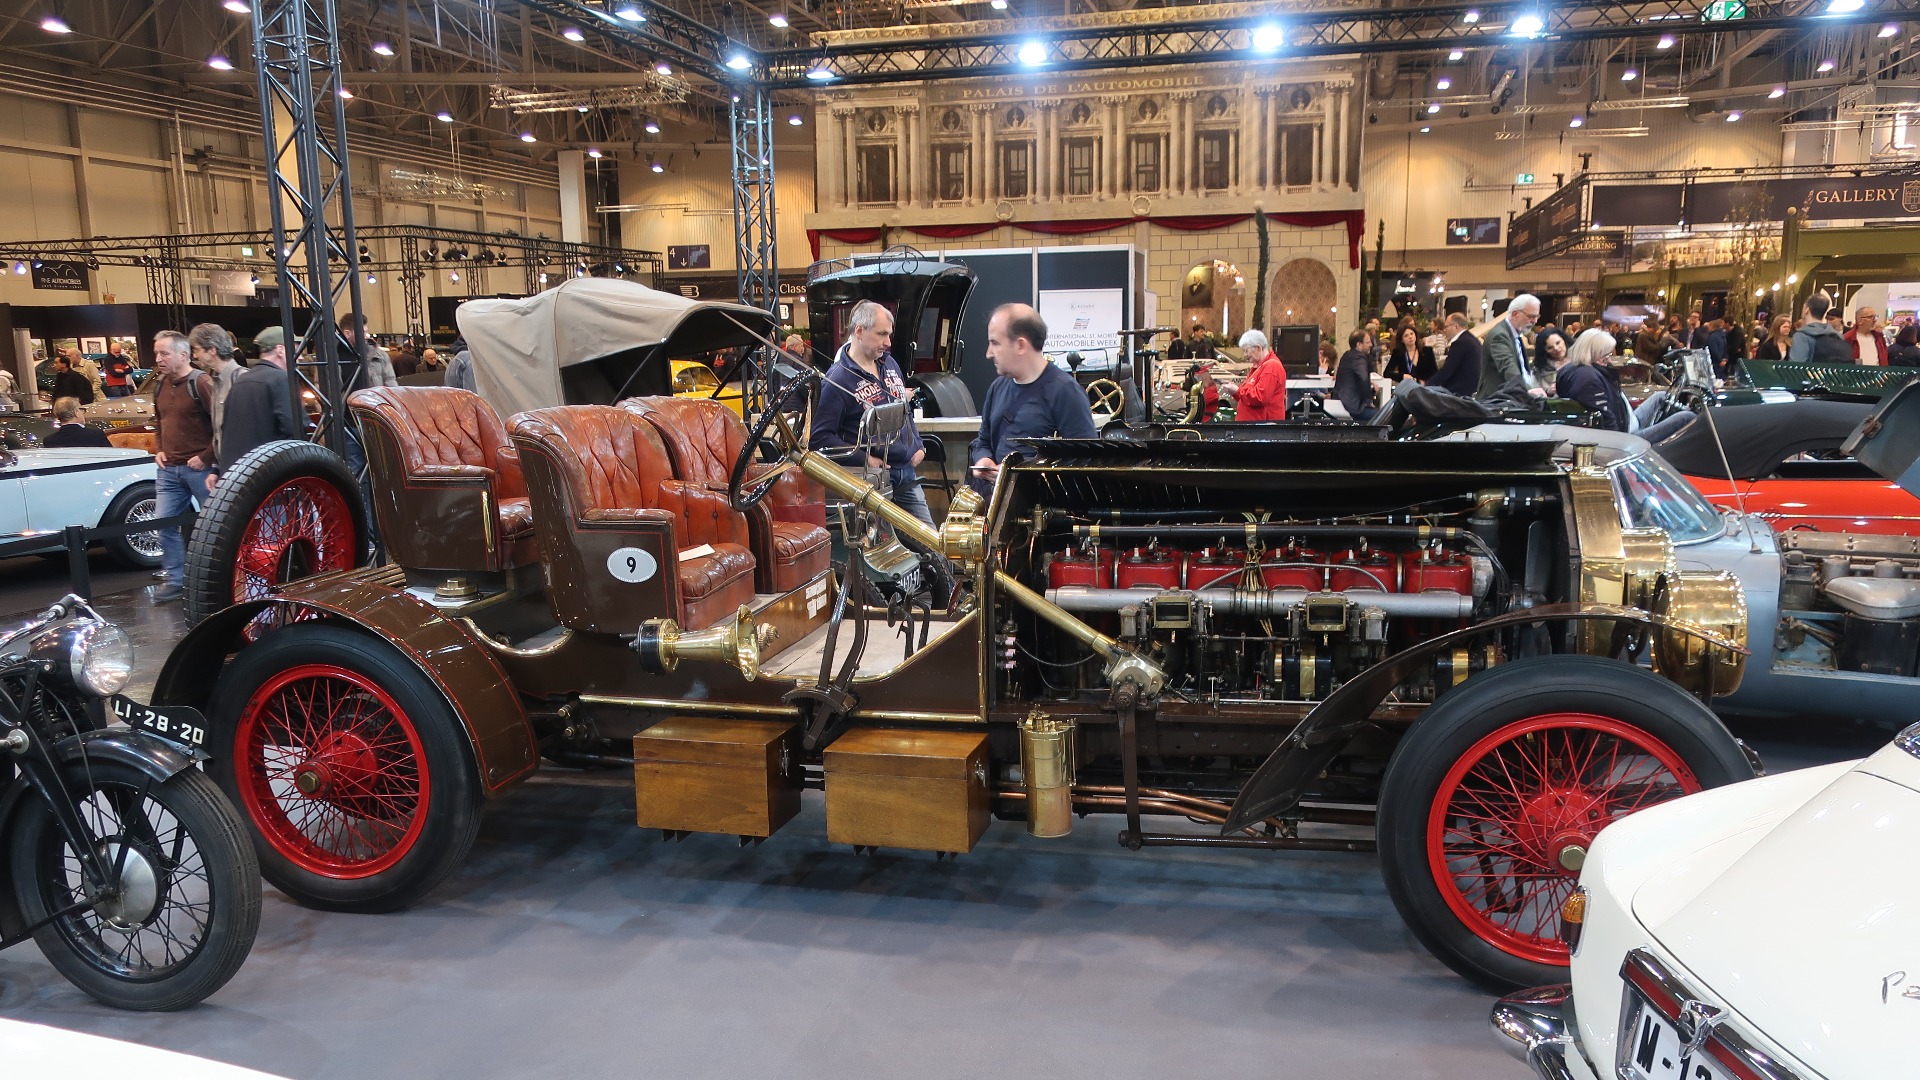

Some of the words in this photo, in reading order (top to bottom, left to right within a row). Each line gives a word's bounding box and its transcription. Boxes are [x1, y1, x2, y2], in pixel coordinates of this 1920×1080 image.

[963, 86, 1024, 98] PALAIS
[1034, 84, 1057, 95] DE
[1068, 76, 1204, 93] L'AUTOMOBILE
[1816, 188, 1899, 203] GALLERY
[1449, 220, 1457, 232] 4
[669, 247, 676, 258] 4
[779, 283, 807, 294] Class
[1044, 339, 1095, 347] AUTOMOBILE
[854, 382, 881, 402] RHODE
[626, 556, 637, 573] 9
